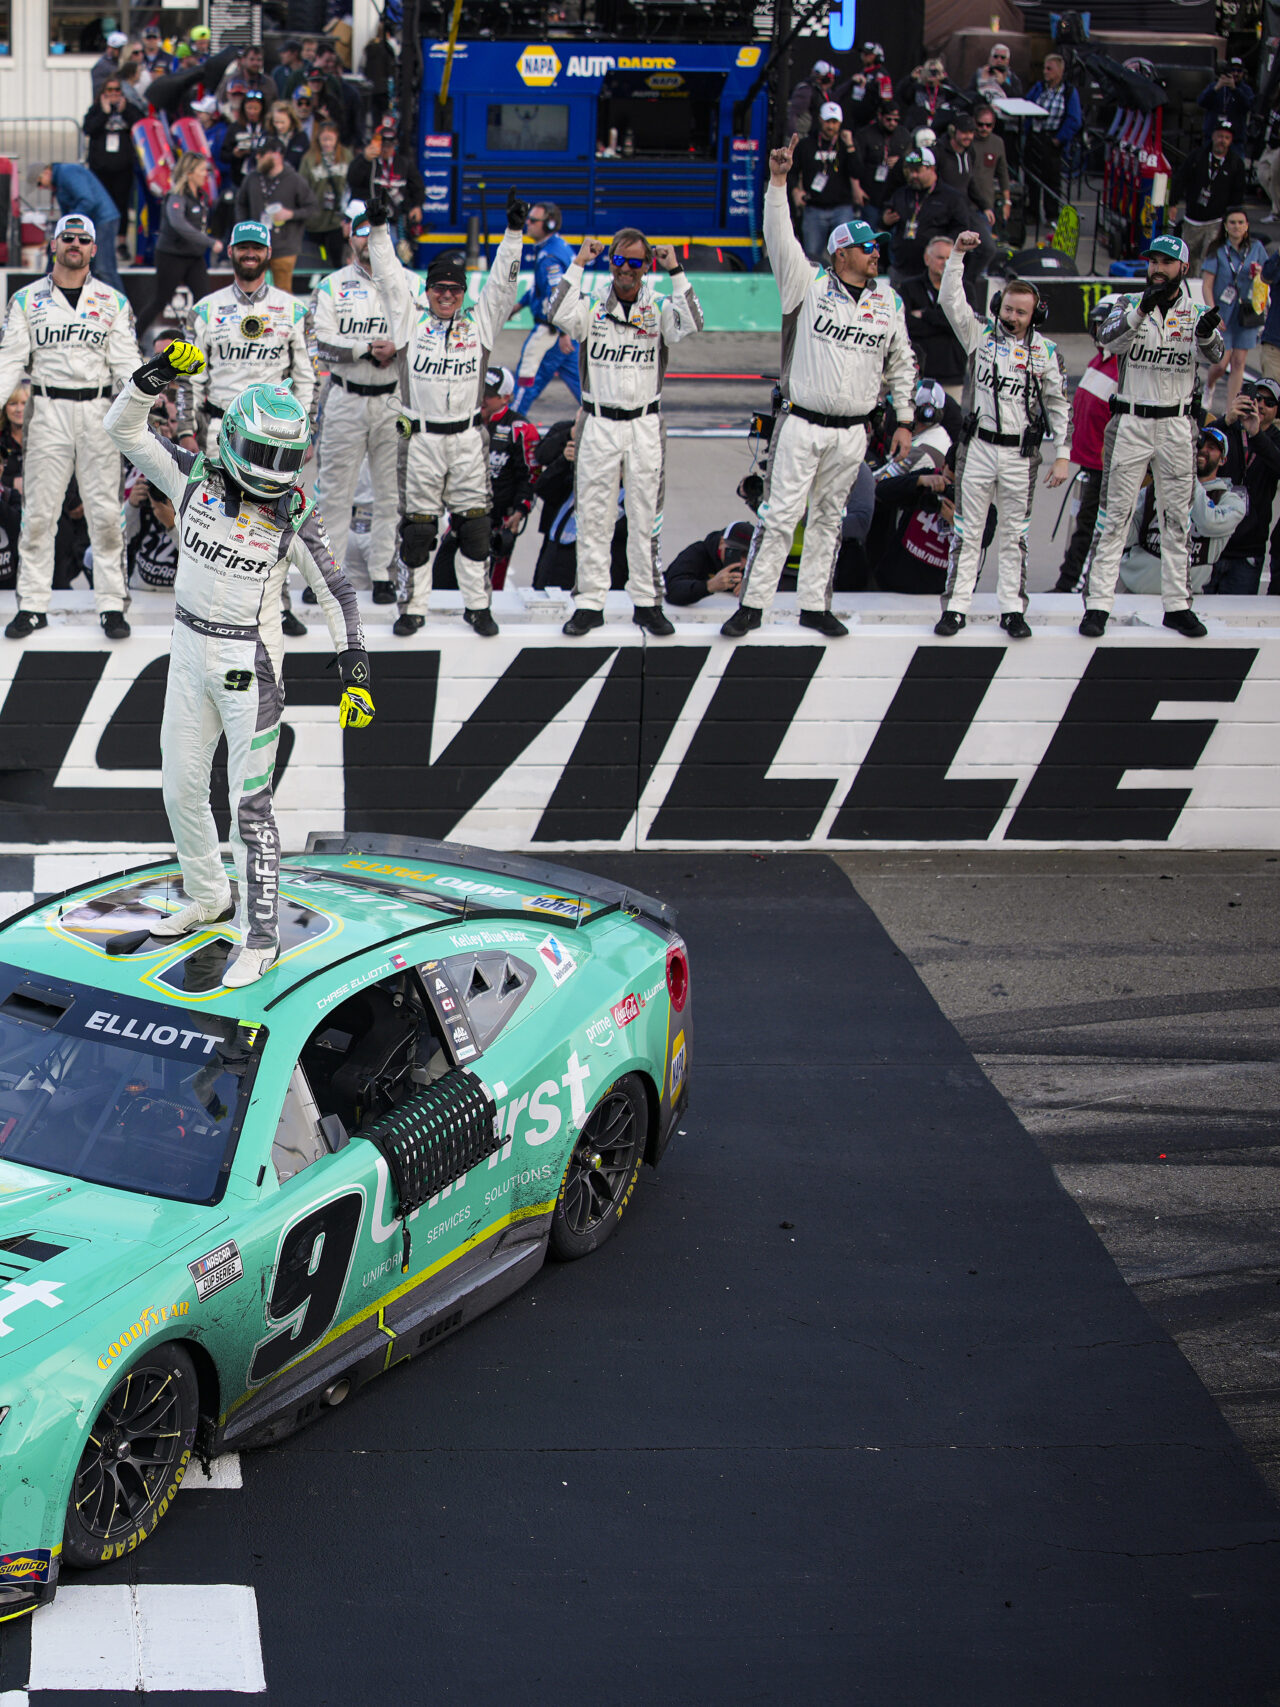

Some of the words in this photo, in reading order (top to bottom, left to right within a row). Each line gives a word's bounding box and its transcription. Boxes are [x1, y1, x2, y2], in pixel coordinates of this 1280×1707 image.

[523, 57, 555, 75] NAPA
[566, 55, 616, 77] AUTO
[735, 46, 761, 68] 9
[35, 323, 108, 346] UniFirst
[339, 316, 388, 335] UniFi
[813, 314, 886, 348] UniFirst
[218, 342, 285, 361] UniFirst
[590, 341, 656, 363] UniFirst
[1129, 343, 1192, 366] UniFirst
[413, 354, 477, 376] UniFirst
[268, 424, 296, 436] UniFirst
[267, 437, 293, 449] UniFirst
[188, 504, 217, 522] GOODYEAR
[188, 513, 211, 530] UniFirst
[183, 526, 269, 575] UniFirst
[248, 538, 271, 551] Coca-Cola
[905, 538, 950, 569] TEAM/DRIV
[192, 619, 250, 637] ELLIOTT
[224, 667, 255, 692] 9
[248, 820, 278, 920] UniFirst
[342, 859, 439, 882] PARTS
[433, 876, 518, 898] AUTO
[528, 896, 584, 917] NAPA
[449, 931, 483, 949] Kelley
[483, 931, 504, 945] Blue
[504, 929, 529, 944] Book
[553, 960, 576, 982] Valvoline
[317, 983, 350, 1010] CHASE
[350, 963, 391, 989] ELLIOTT
[643, 977, 667, 1002] LLumar
[613, 995, 639, 1027] Coca-Cola
[84, 1010, 226, 1056] ELLIOTT
[585, 1014, 613, 1044] prime
[371, 1050, 595, 1245] Uirst
[615, 1157, 642, 1222] EAGLE
[426, 1205, 471, 1245] SERVICES
[484, 1164, 552, 1206] SOLUTIONS
[205, 1245, 232, 1271] NASCAR
[202, 1273, 218, 1292] CUP
[216, 1262, 237, 1287] SERIES
[246, 1183, 367, 1390] 9
[96, 1301, 190, 1371] GOODYEAR
[100, 1449, 191, 1561] GOODYEAR
